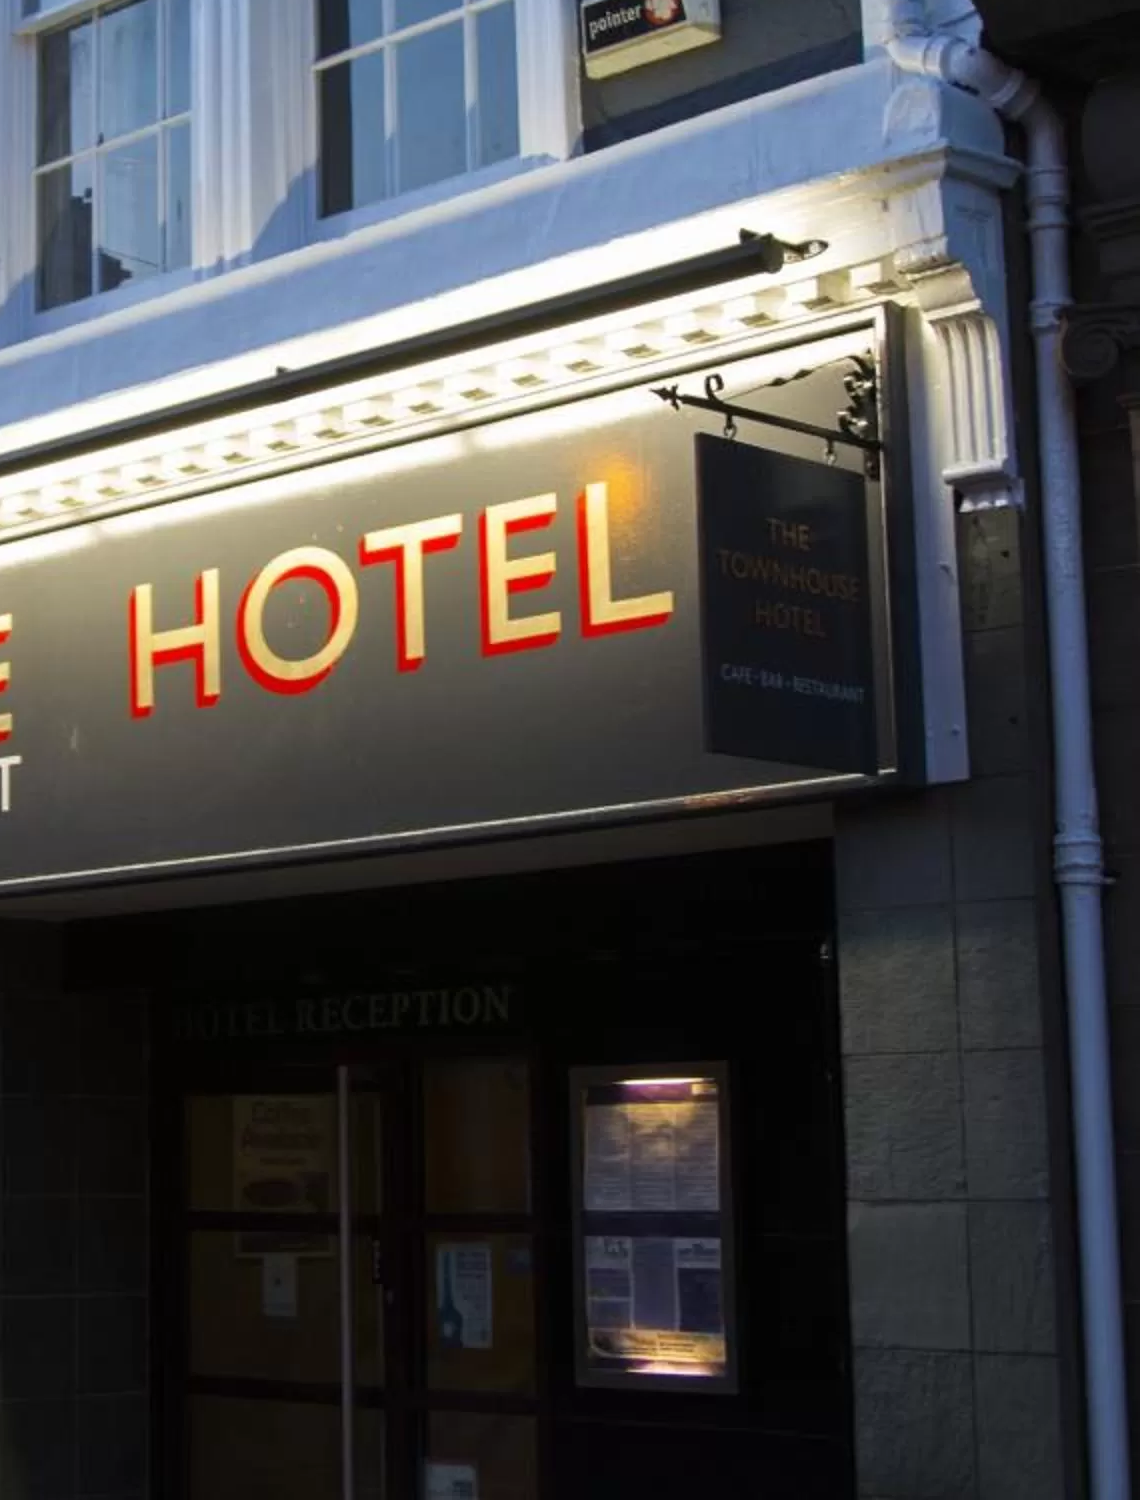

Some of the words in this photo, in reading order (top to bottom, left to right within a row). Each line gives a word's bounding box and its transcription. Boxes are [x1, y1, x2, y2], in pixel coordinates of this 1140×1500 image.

[588, 3, 641, 41] pointer
[764, 516, 812, 552] THE
[715, 547, 860, 602] TOWNHOUSE
[129, 481, 674, 718] HOTEL
[754, 598, 827, 638] HOTEL
[295, 984, 513, 1034] RECEPTION
